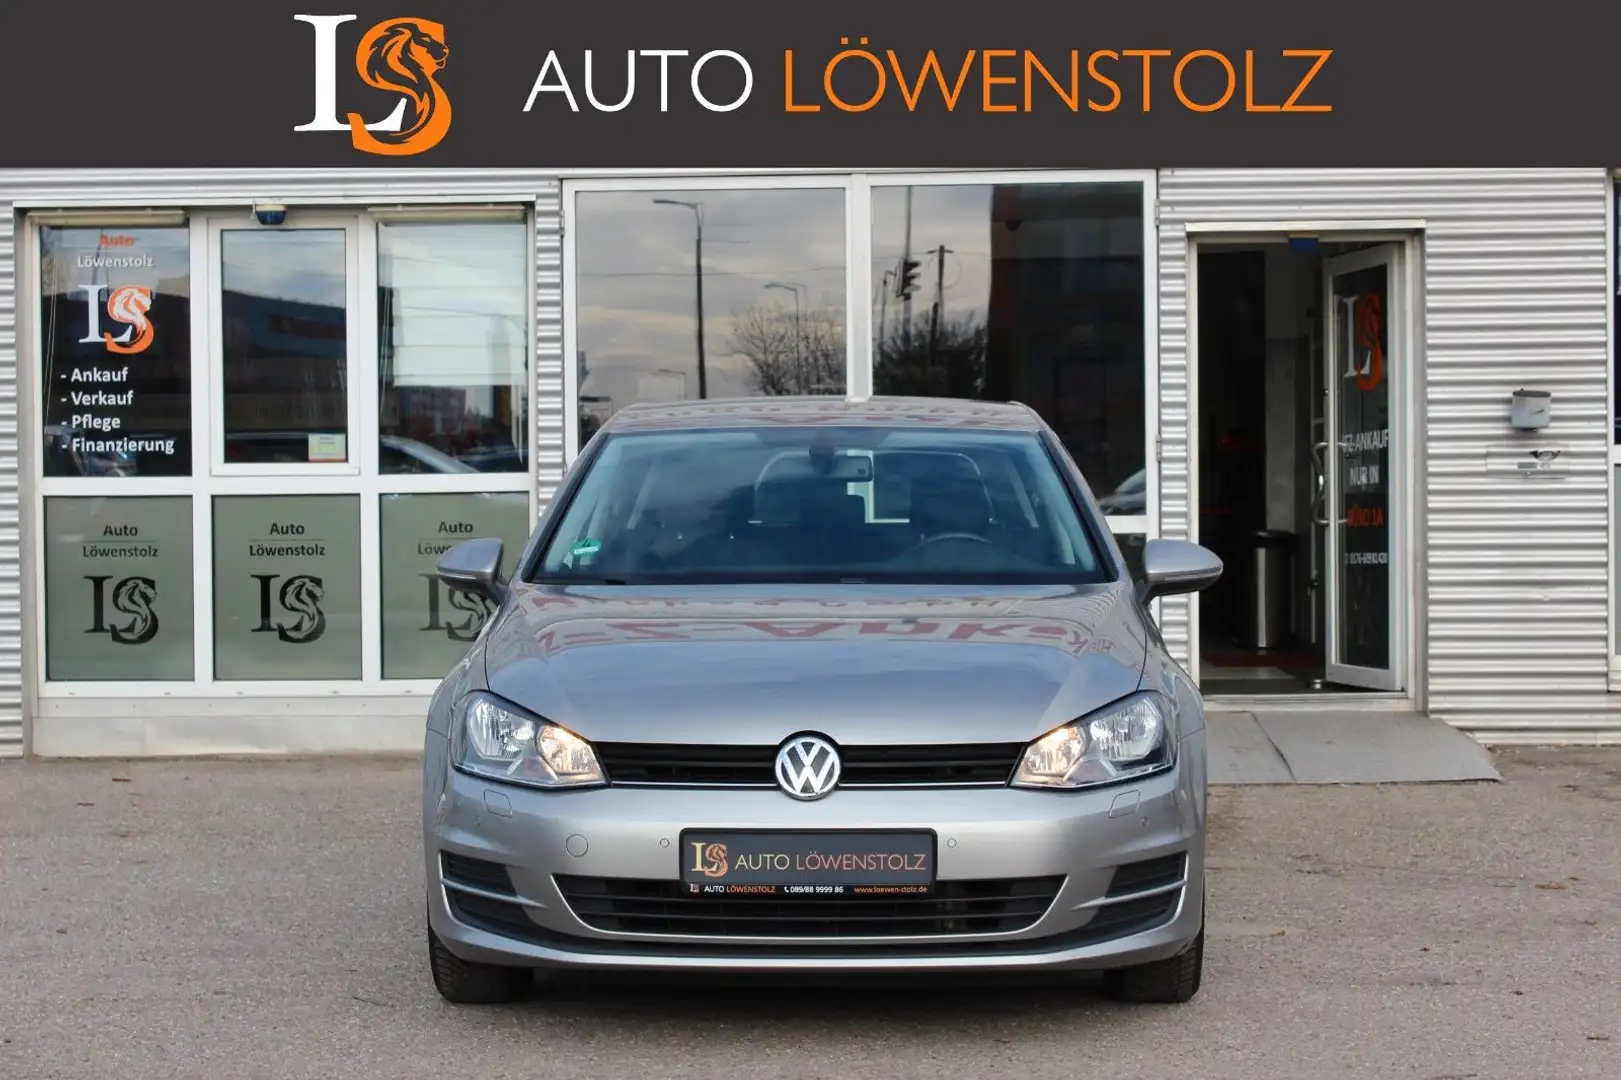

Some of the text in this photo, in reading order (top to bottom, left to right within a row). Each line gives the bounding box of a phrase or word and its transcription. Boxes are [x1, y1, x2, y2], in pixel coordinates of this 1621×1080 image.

[99, 234, 136, 247] Auto
[77, 255, 154, 268] Löwenstolz
[71, 367, 129, 382] Ankauf
[71, 390, 134, 406] Verkauf
[72, 413, 121, 432] Pflege
[72, 437, 175, 454] Finanzierung
[103, 525, 139, 536] Auto
[270, 522, 305, 535] Auto
[438, 521, 474, 533] Auto
[83, 545, 159, 557] Löwenstolz
[249, 544, 326, 556] Löwenstolz
[775, 736, 840, 797] VW
[735, 850, 926, 870] AUTO LÖWENSTOLZ
[704, 884, 776, 893] AUTO LÖWENSTOLZ
[789, 885, 844, 894] 089/88 9999 86
[853, 885, 928, 893] www.loewen-stolz.de
